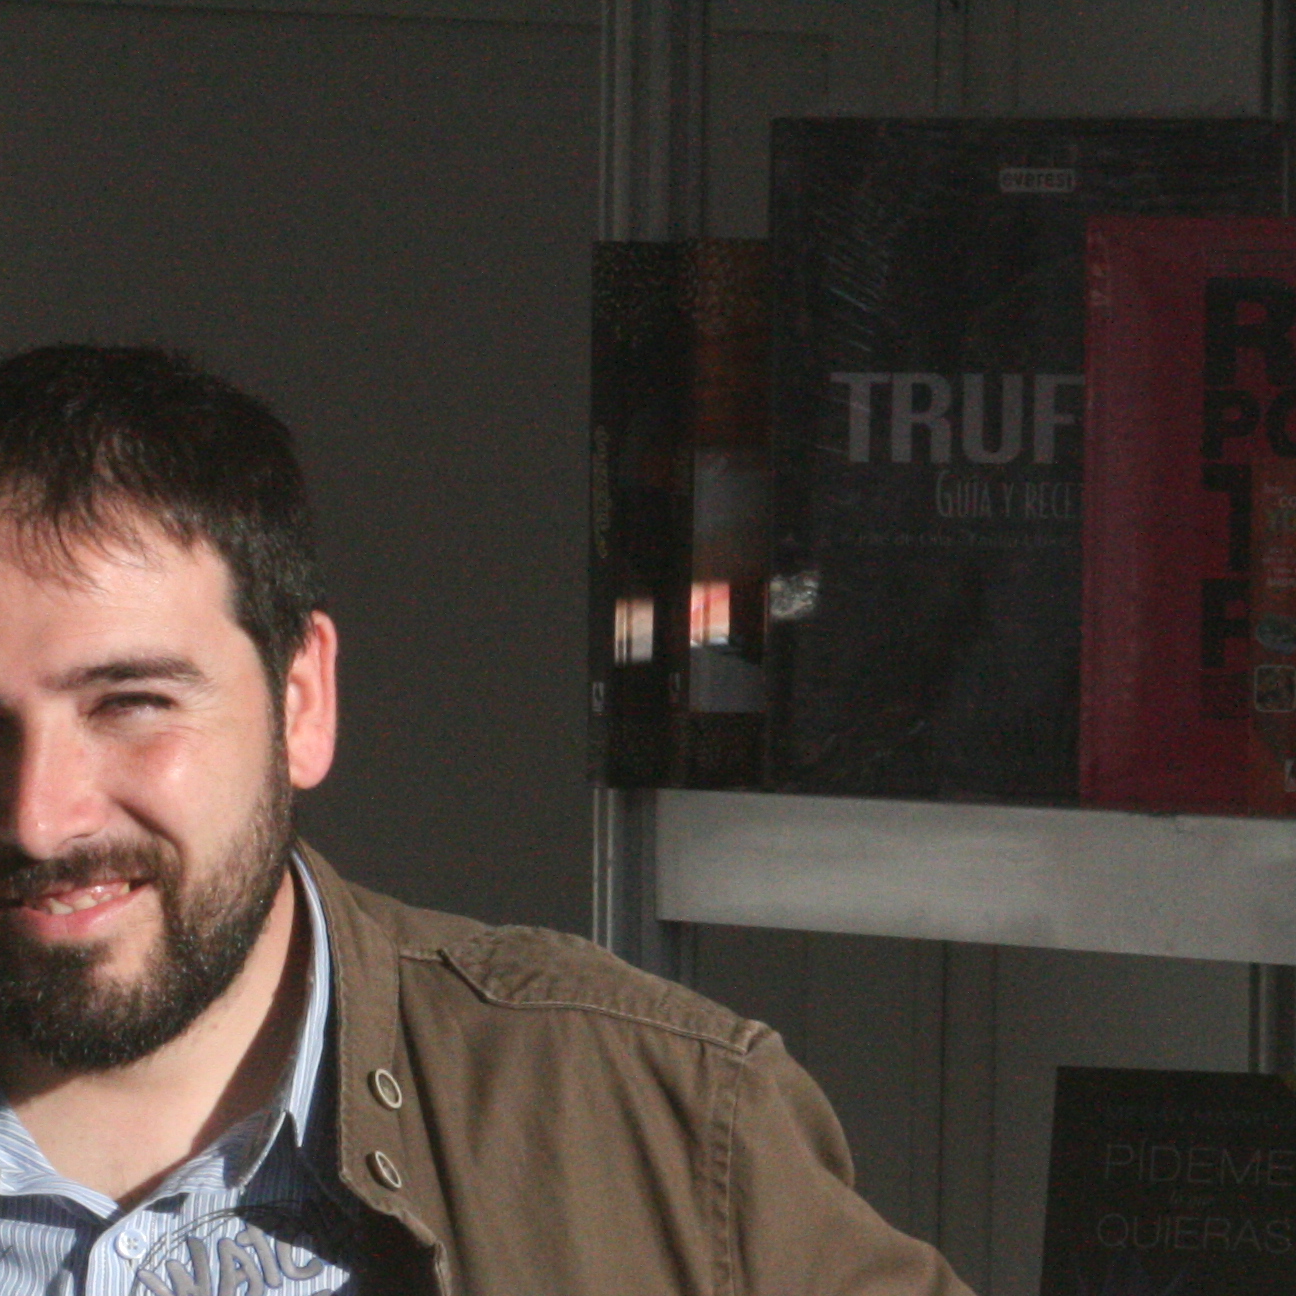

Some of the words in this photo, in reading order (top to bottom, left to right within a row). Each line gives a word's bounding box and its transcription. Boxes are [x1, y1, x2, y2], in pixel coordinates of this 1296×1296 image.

[1003, 168, 1074, 192] everest
[1103, 1140, 1296, 1190] PÍDEME
[1095, 1212, 1293, 1256] QUIERAS
